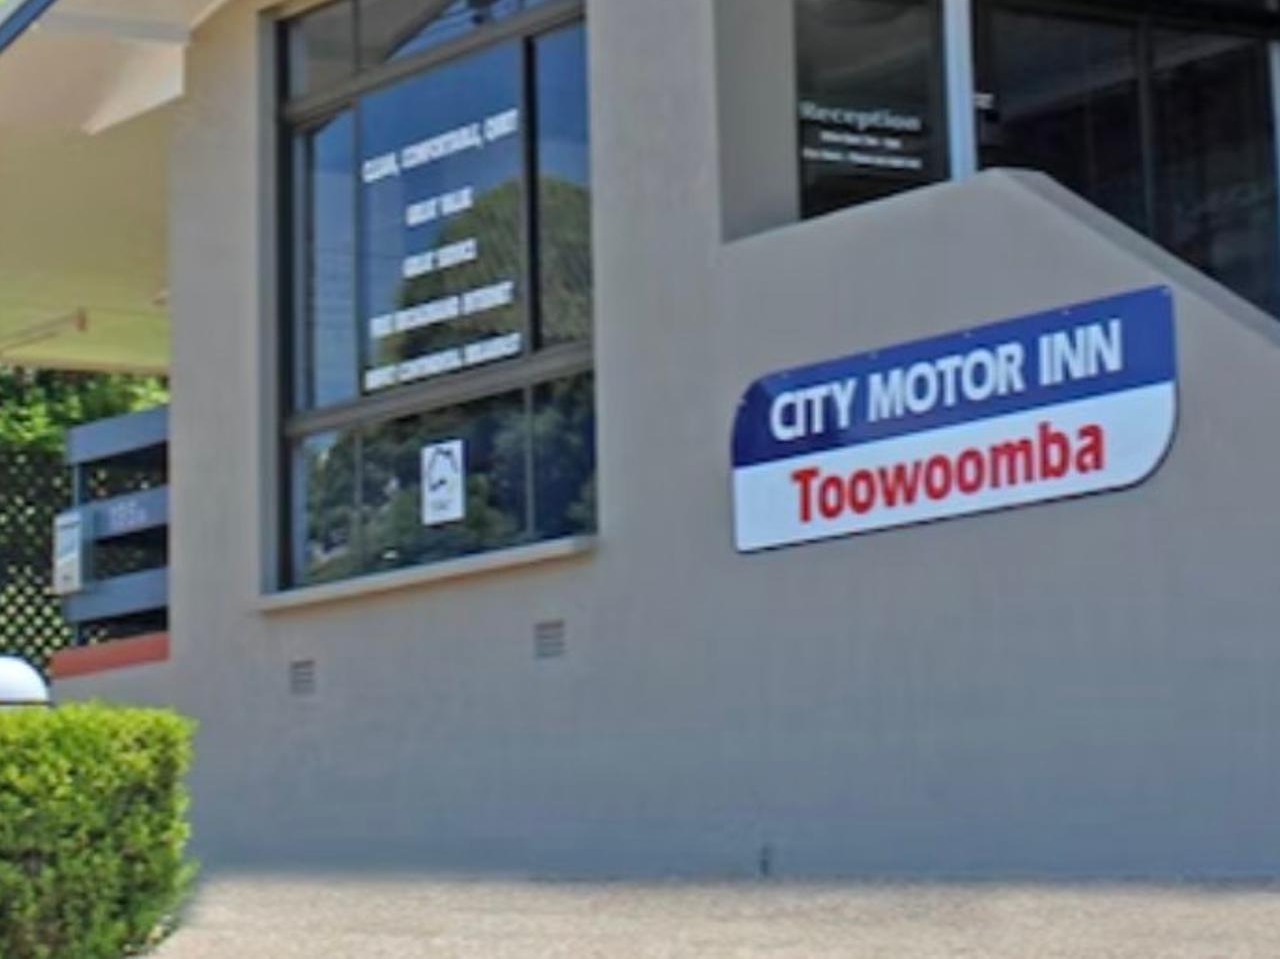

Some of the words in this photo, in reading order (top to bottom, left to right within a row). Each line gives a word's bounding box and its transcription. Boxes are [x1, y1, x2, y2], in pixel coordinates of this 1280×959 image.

[799, 101, 921, 130] Reception
[770, 377, 857, 442] CITY
[867, 341, 1026, 423] MOTOR
[1038, 318, 1124, 386] INN
[791, 420, 1106, 523] Toowoomba
